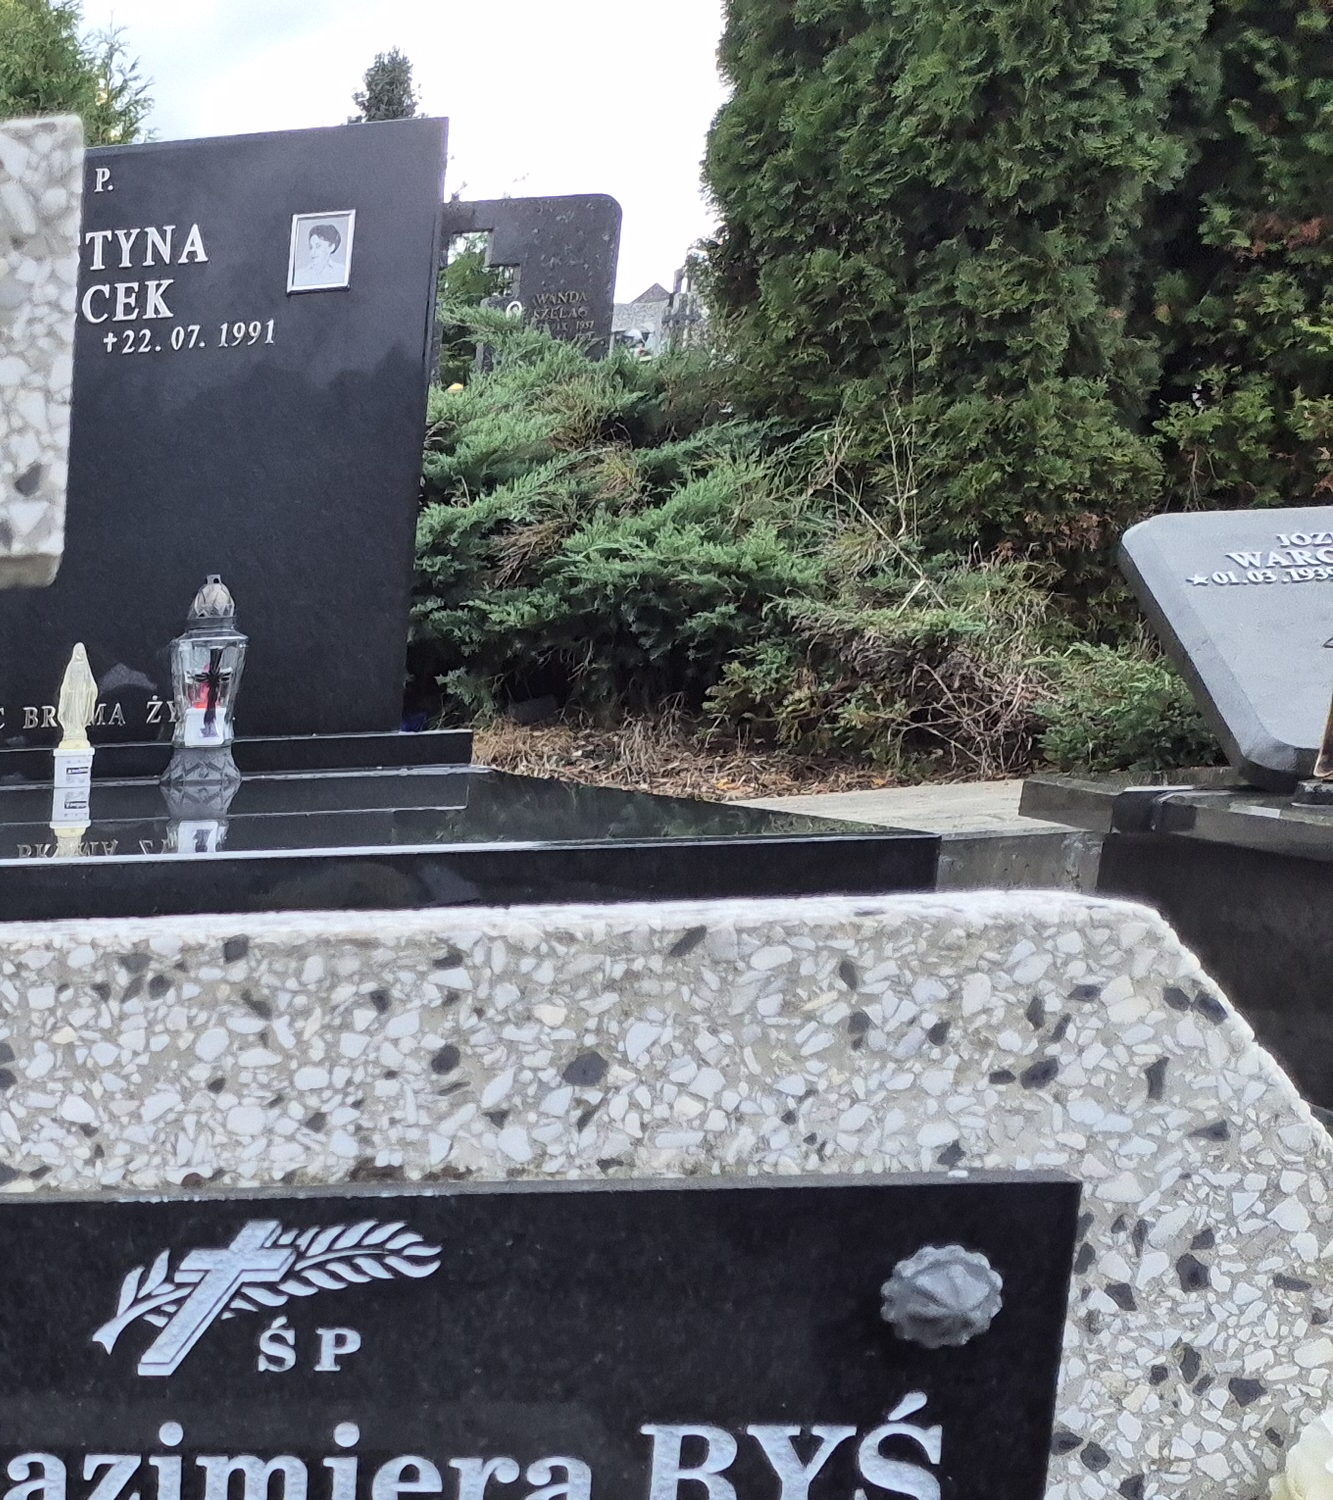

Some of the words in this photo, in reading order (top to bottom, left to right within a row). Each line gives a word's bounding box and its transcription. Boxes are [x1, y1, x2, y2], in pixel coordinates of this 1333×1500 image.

[84, 222, 209, 271] TYNA
[80, 278, 175, 324] CEK
[218, 318, 275, 347] 1991
